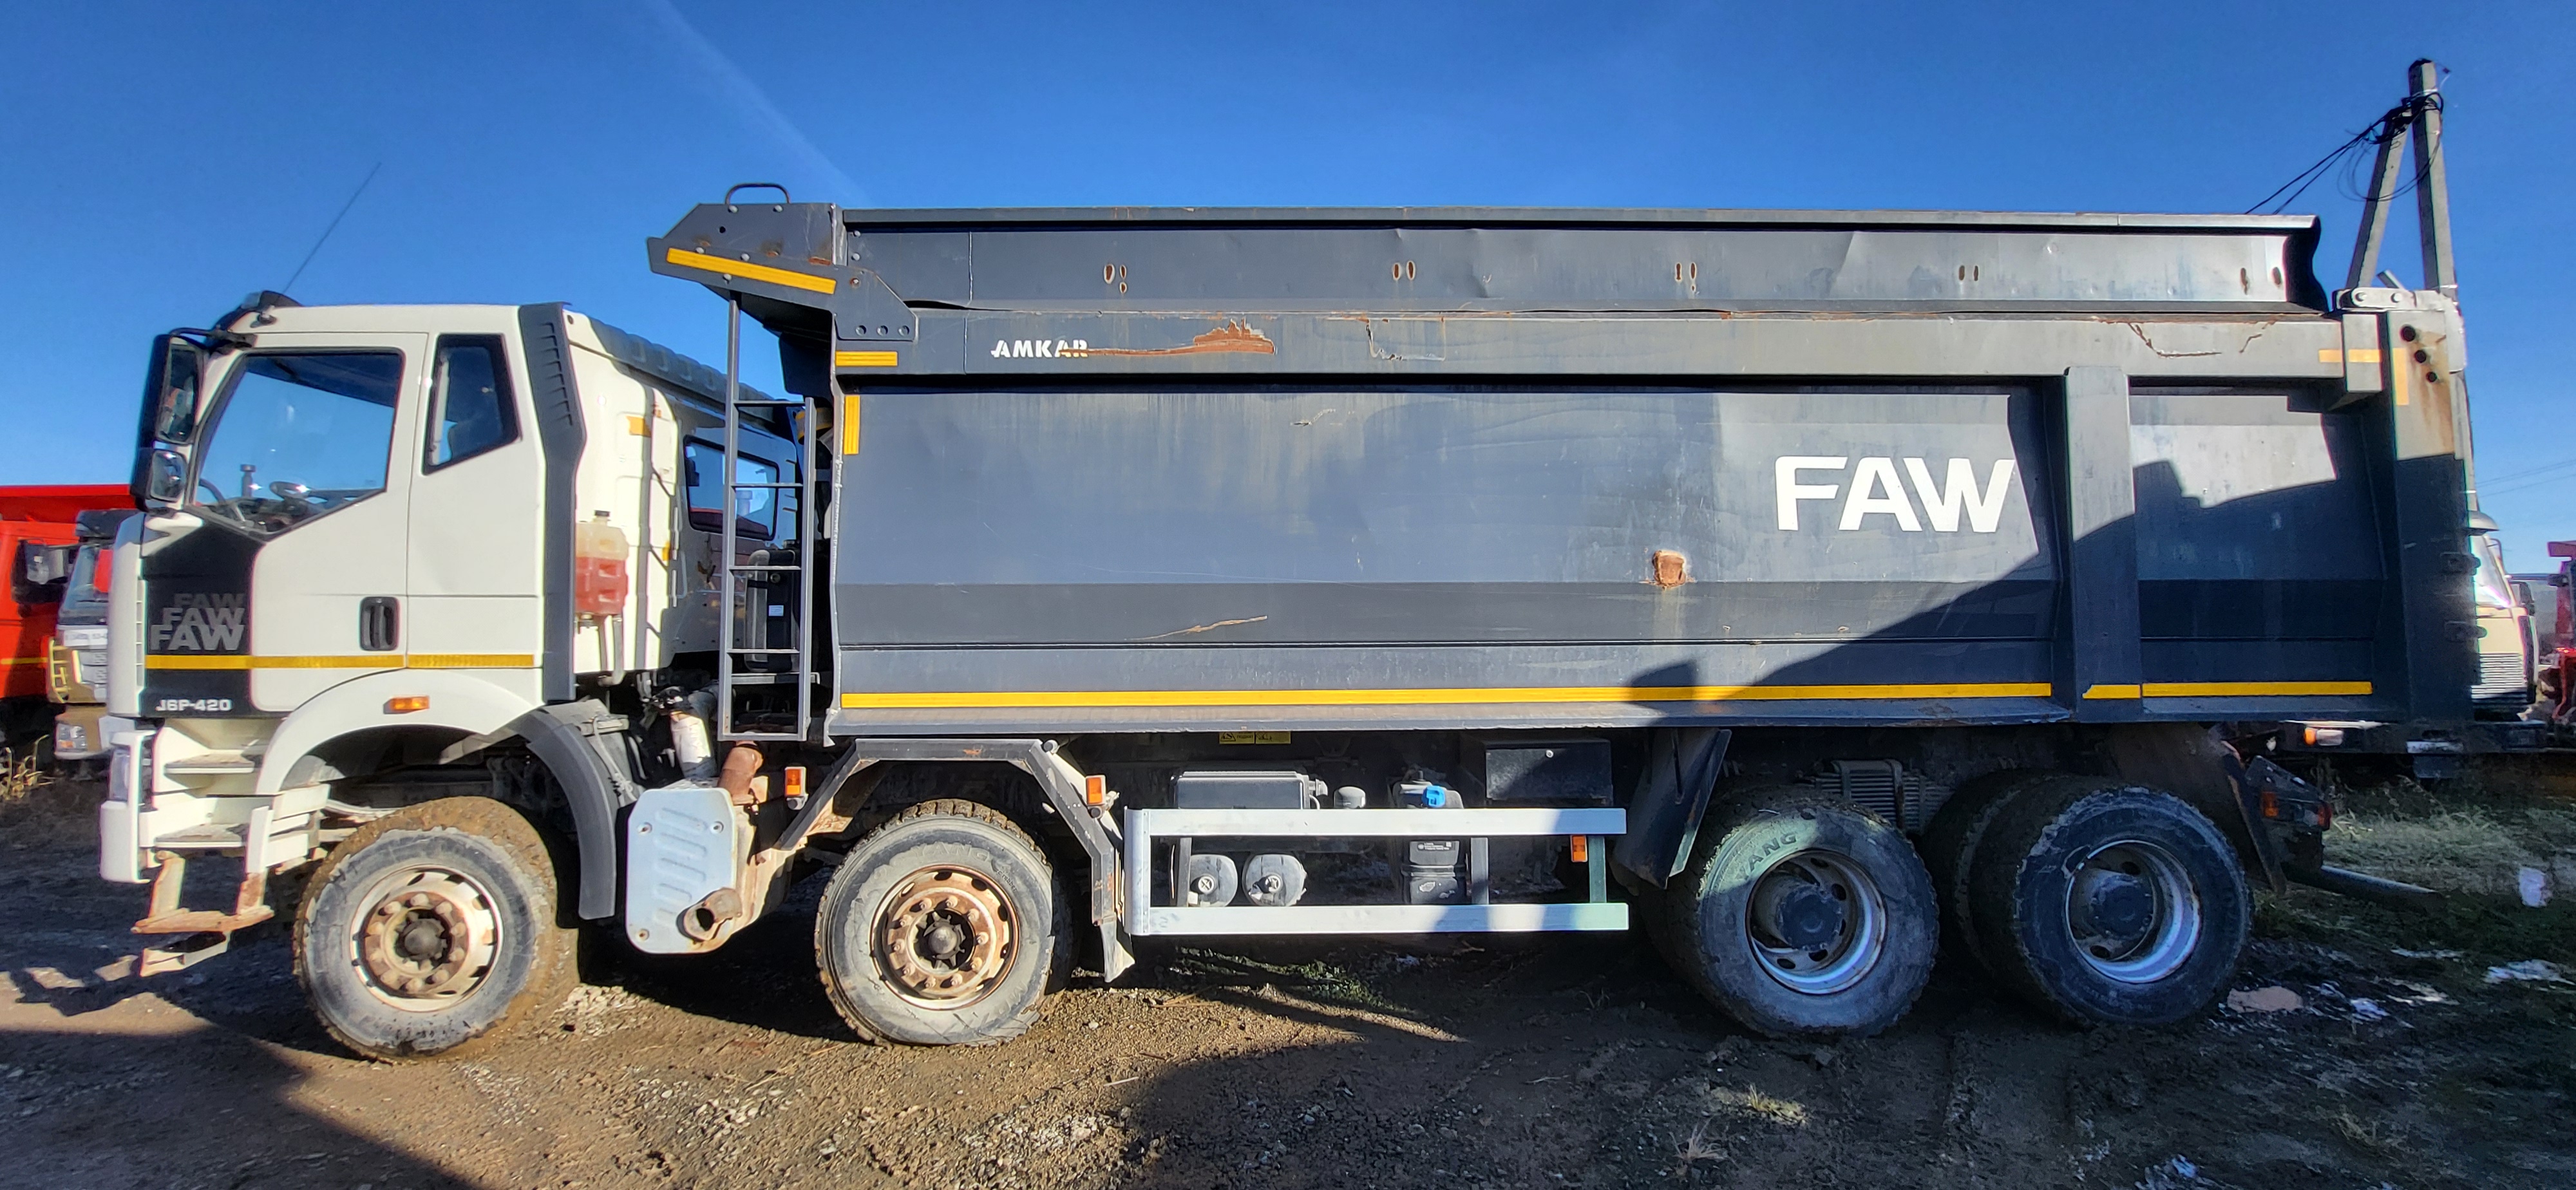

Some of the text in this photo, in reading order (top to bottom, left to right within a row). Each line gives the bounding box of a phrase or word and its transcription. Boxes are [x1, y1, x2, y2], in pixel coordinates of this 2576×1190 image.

[990, 339, 1088, 358] AMKAR
[1775, 455, 2016, 533] FAW
[174, 593, 244, 608] FAW
[162, 607, 245, 626] FAW
[150, 624, 245, 650] FAW
[156, 699, 232, 712] J6P-420
